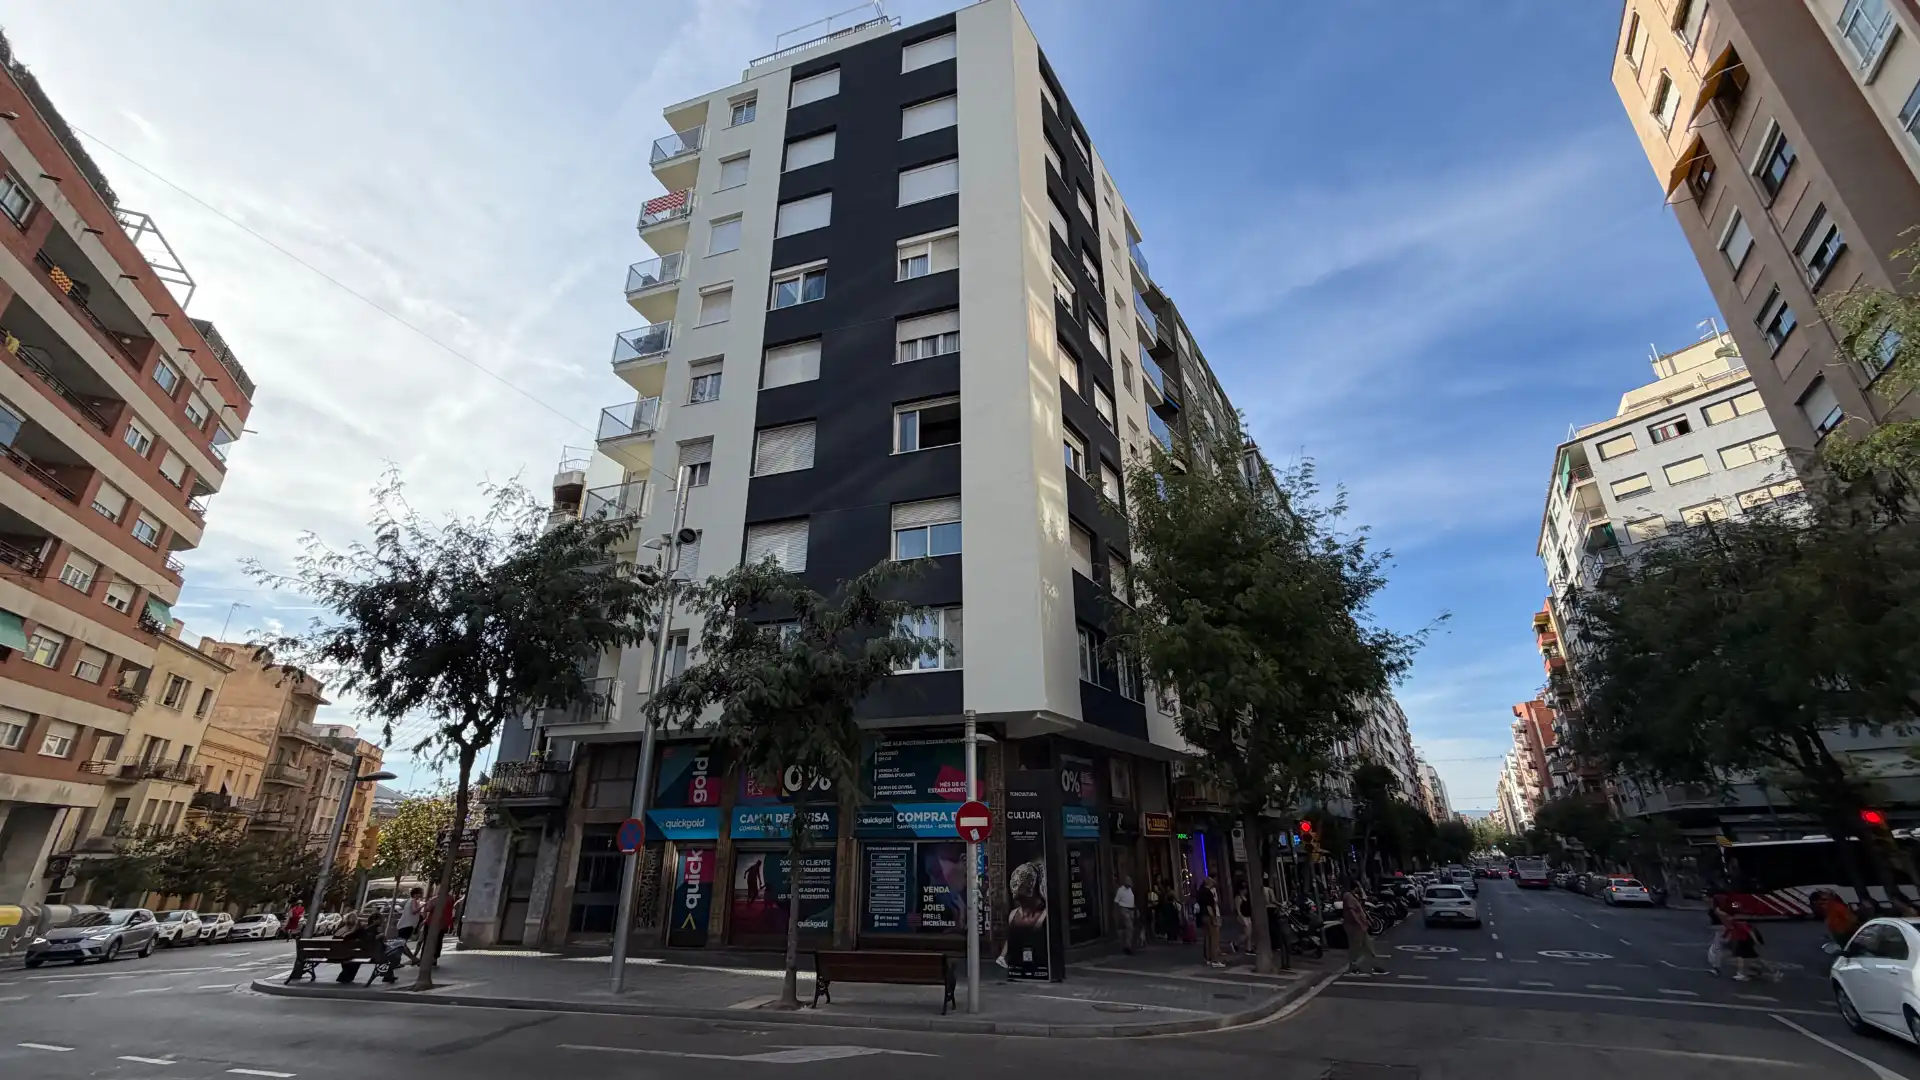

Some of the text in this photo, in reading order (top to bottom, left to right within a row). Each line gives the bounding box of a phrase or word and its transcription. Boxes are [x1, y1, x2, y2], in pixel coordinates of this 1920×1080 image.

[692, 756, 709, 803] gold
[775, 813, 791, 823] DE
[862, 816, 892, 825] quickgold
[897, 811, 949, 823] COMPRA
[1007, 811, 1041, 820] CULTURA
[664, 817, 706, 830] quickgold
[685, 848, 704, 909] quick
[923, 885, 950, 893] VENDA
[797, 919, 828, 929] quickgold
